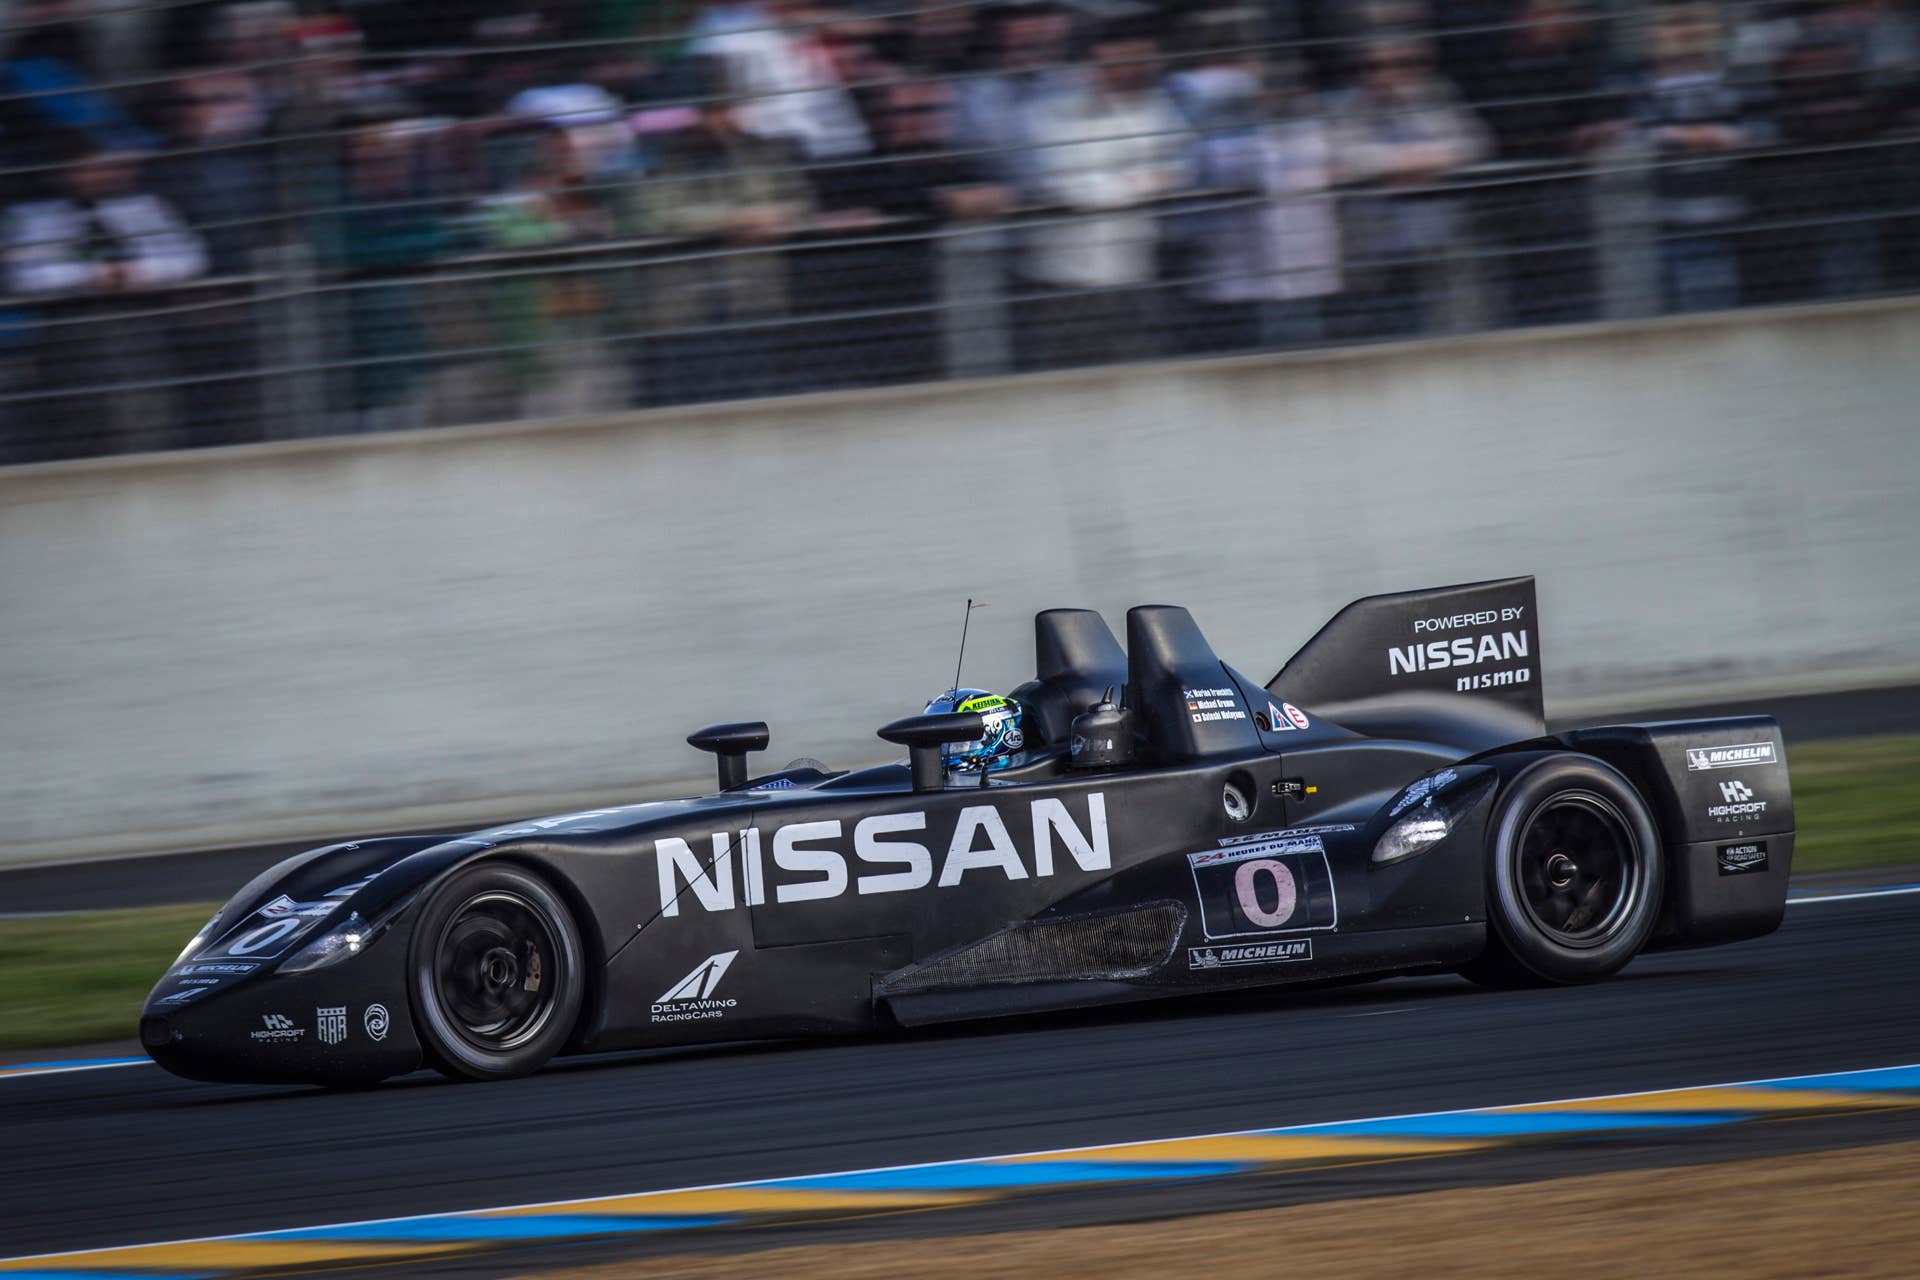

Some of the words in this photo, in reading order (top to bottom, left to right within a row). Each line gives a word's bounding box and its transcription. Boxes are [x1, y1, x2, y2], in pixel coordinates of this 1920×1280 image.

[1414, 610, 1497, 633] POWERED
[1502, 606, 1524, 622] BY
[1388, 630, 1528, 675] NISSAN
[1456, 668, 1530, 691] nismo
[1288, 708, 1304, 723] E
[1711, 746, 1771, 762] MICHELIN
[1708, 802, 1767, 816] HIGHCROFT
[1717, 814, 1760, 823] RACING
[654, 792, 1112, 918] NISSAN
[1195, 852, 1225, 864] 24
[1228, 846, 1266, 858] HEURES
[1269, 842, 1284, 850] DU
[1287, 837, 1319, 847] MANS
[1234, 859, 1297, 927] 0
[228, 919, 300, 955] 0
[1221, 943, 1306, 960] MICHELIN
[651, 999, 737, 1013] DELTAWING
[250, 1029, 305, 1038] HIGHCROFT
